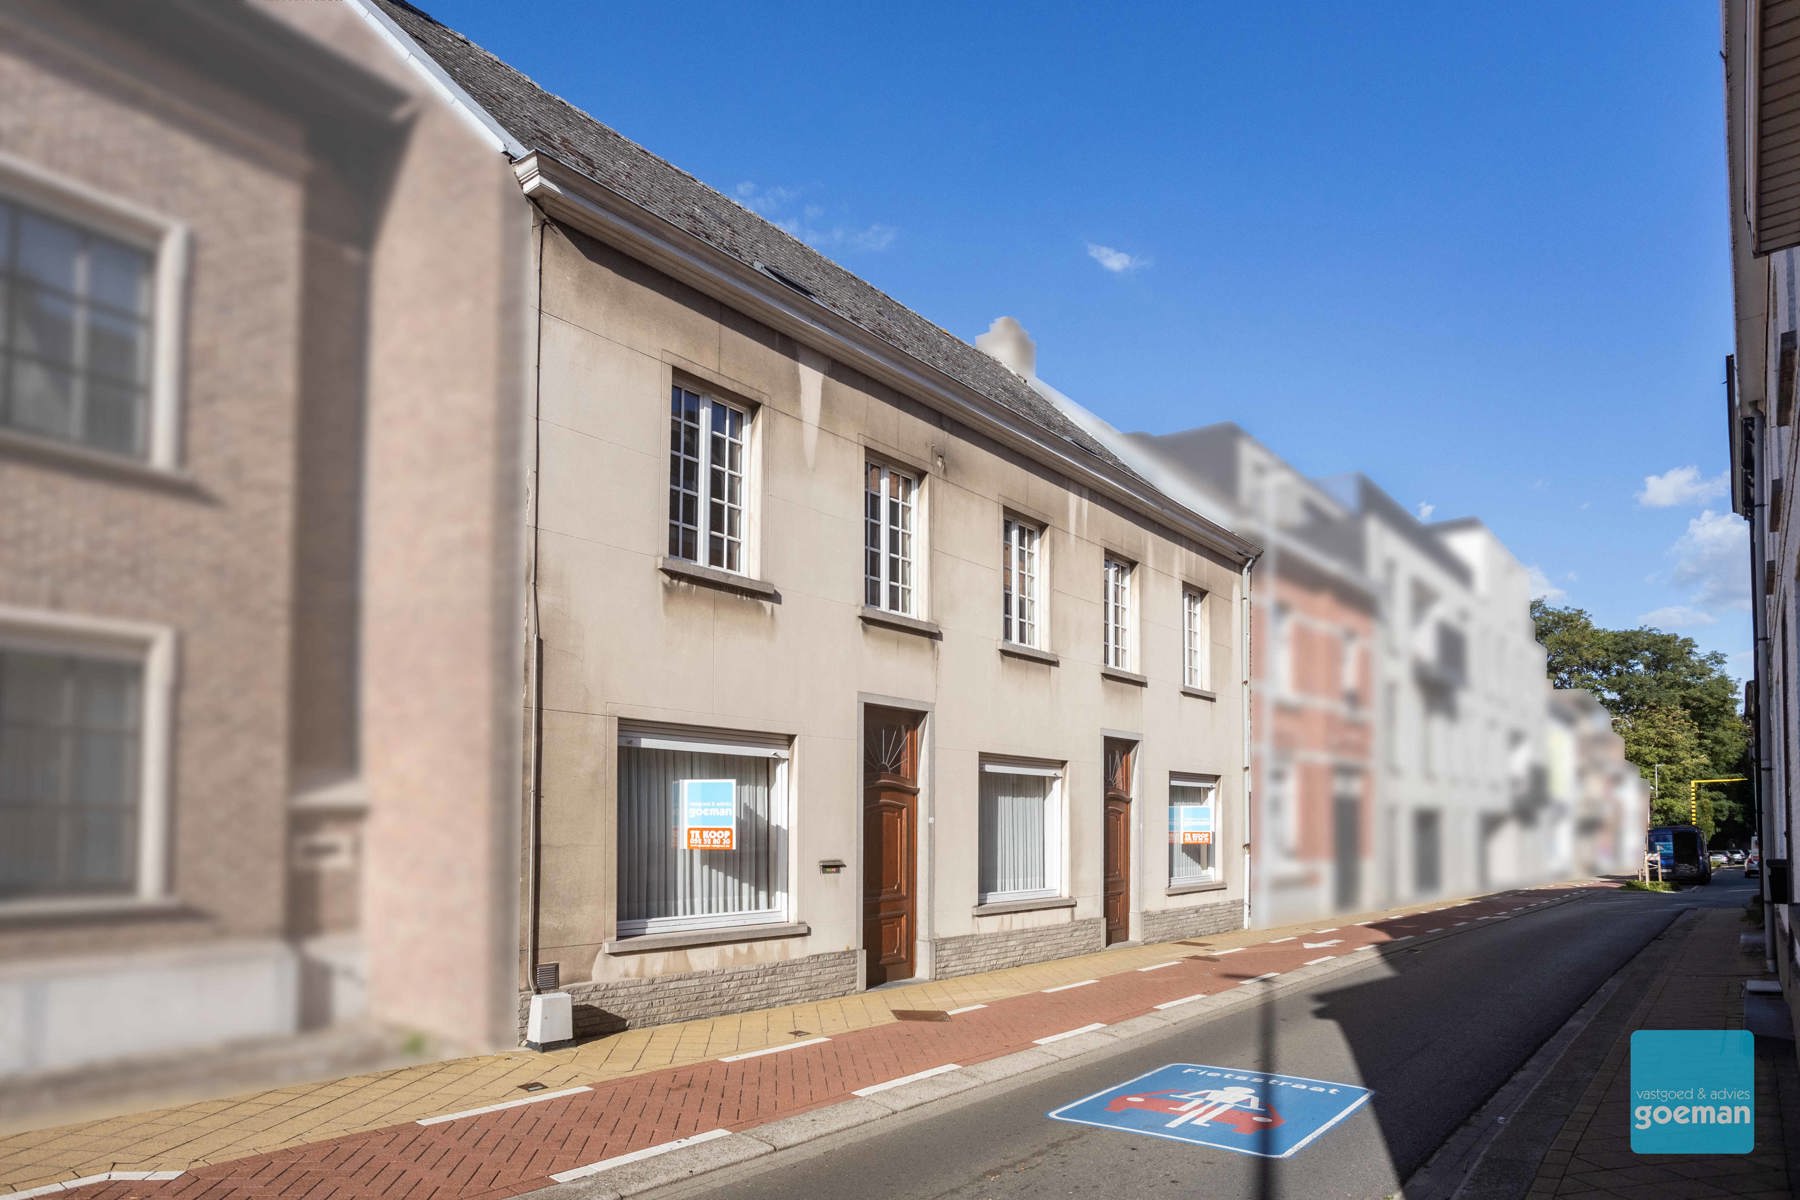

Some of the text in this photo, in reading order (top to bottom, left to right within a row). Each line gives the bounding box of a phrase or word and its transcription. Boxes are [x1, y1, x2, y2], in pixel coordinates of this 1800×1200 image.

[689, 807, 732, 818] goeman
[690, 830, 730, 839] TE KOOP
[1182, 1068, 1341, 1095] Fietsstraat
